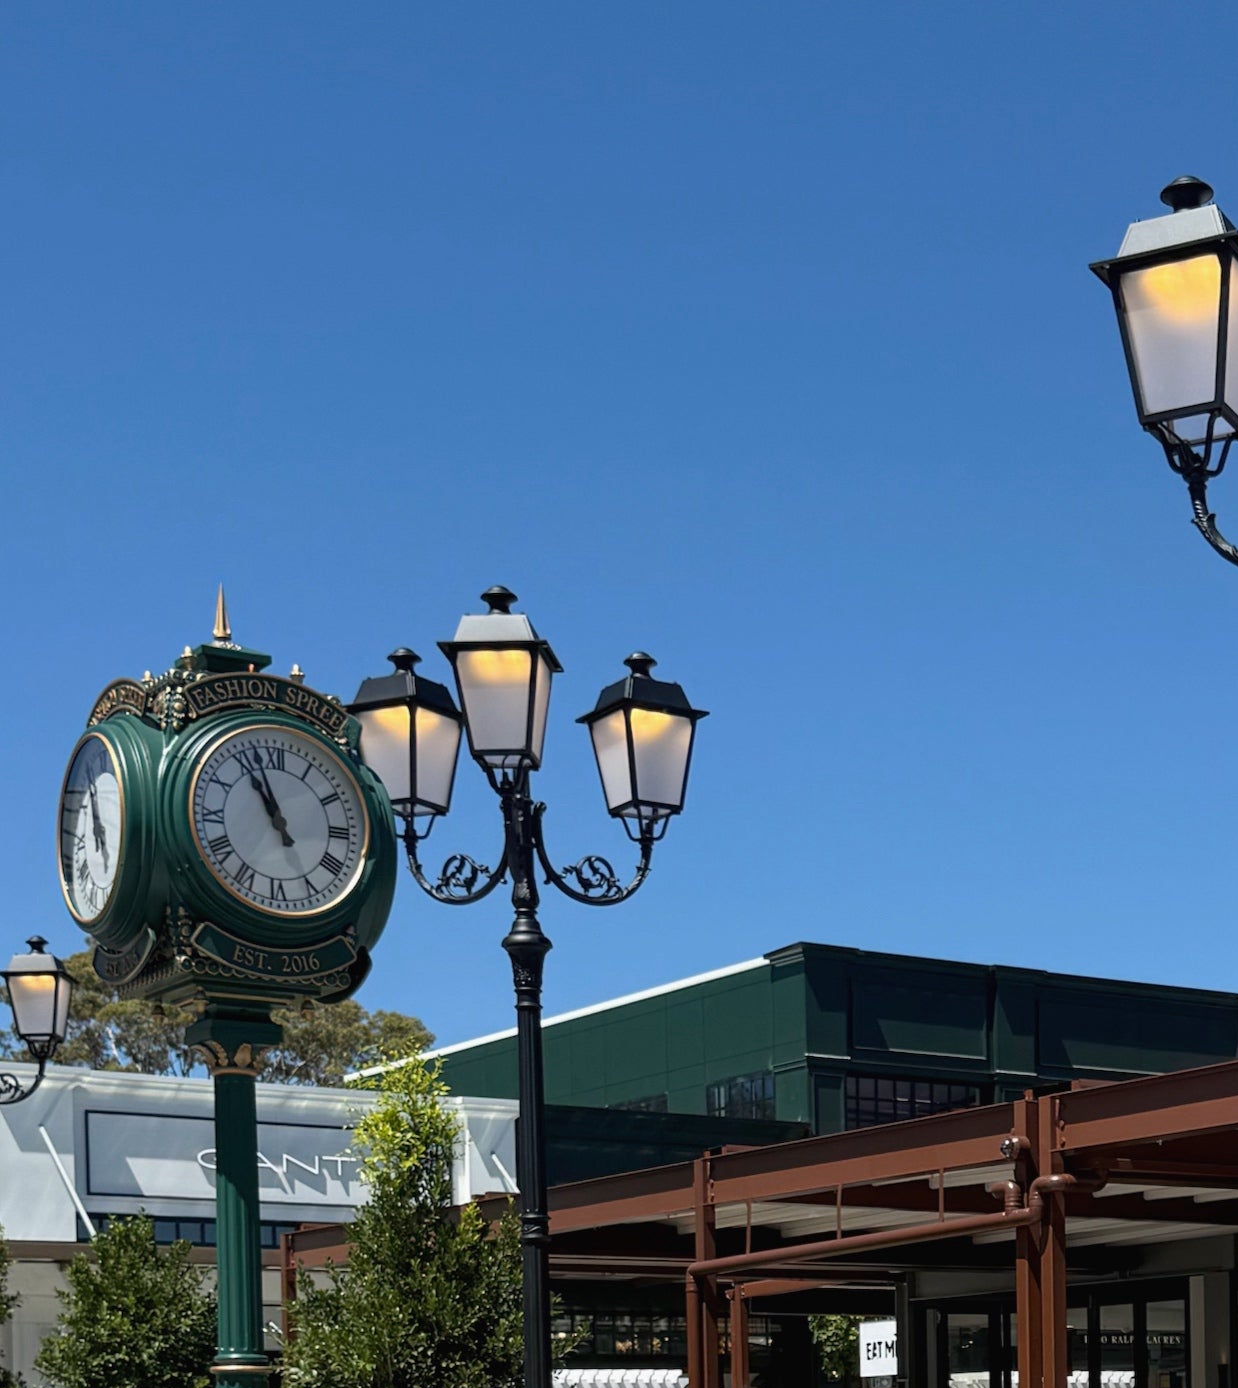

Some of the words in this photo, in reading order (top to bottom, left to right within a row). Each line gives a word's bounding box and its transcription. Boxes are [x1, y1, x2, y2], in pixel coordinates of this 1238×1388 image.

[192, 679, 277, 708] FASHION
[285, 687, 344, 730] SPREE
[232, 944, 272, 970] EST.
[282, 952, 320, 973] 2016
[866, 1341, 883, 1360] EAT
[885, 1340, 898, 1358] M
